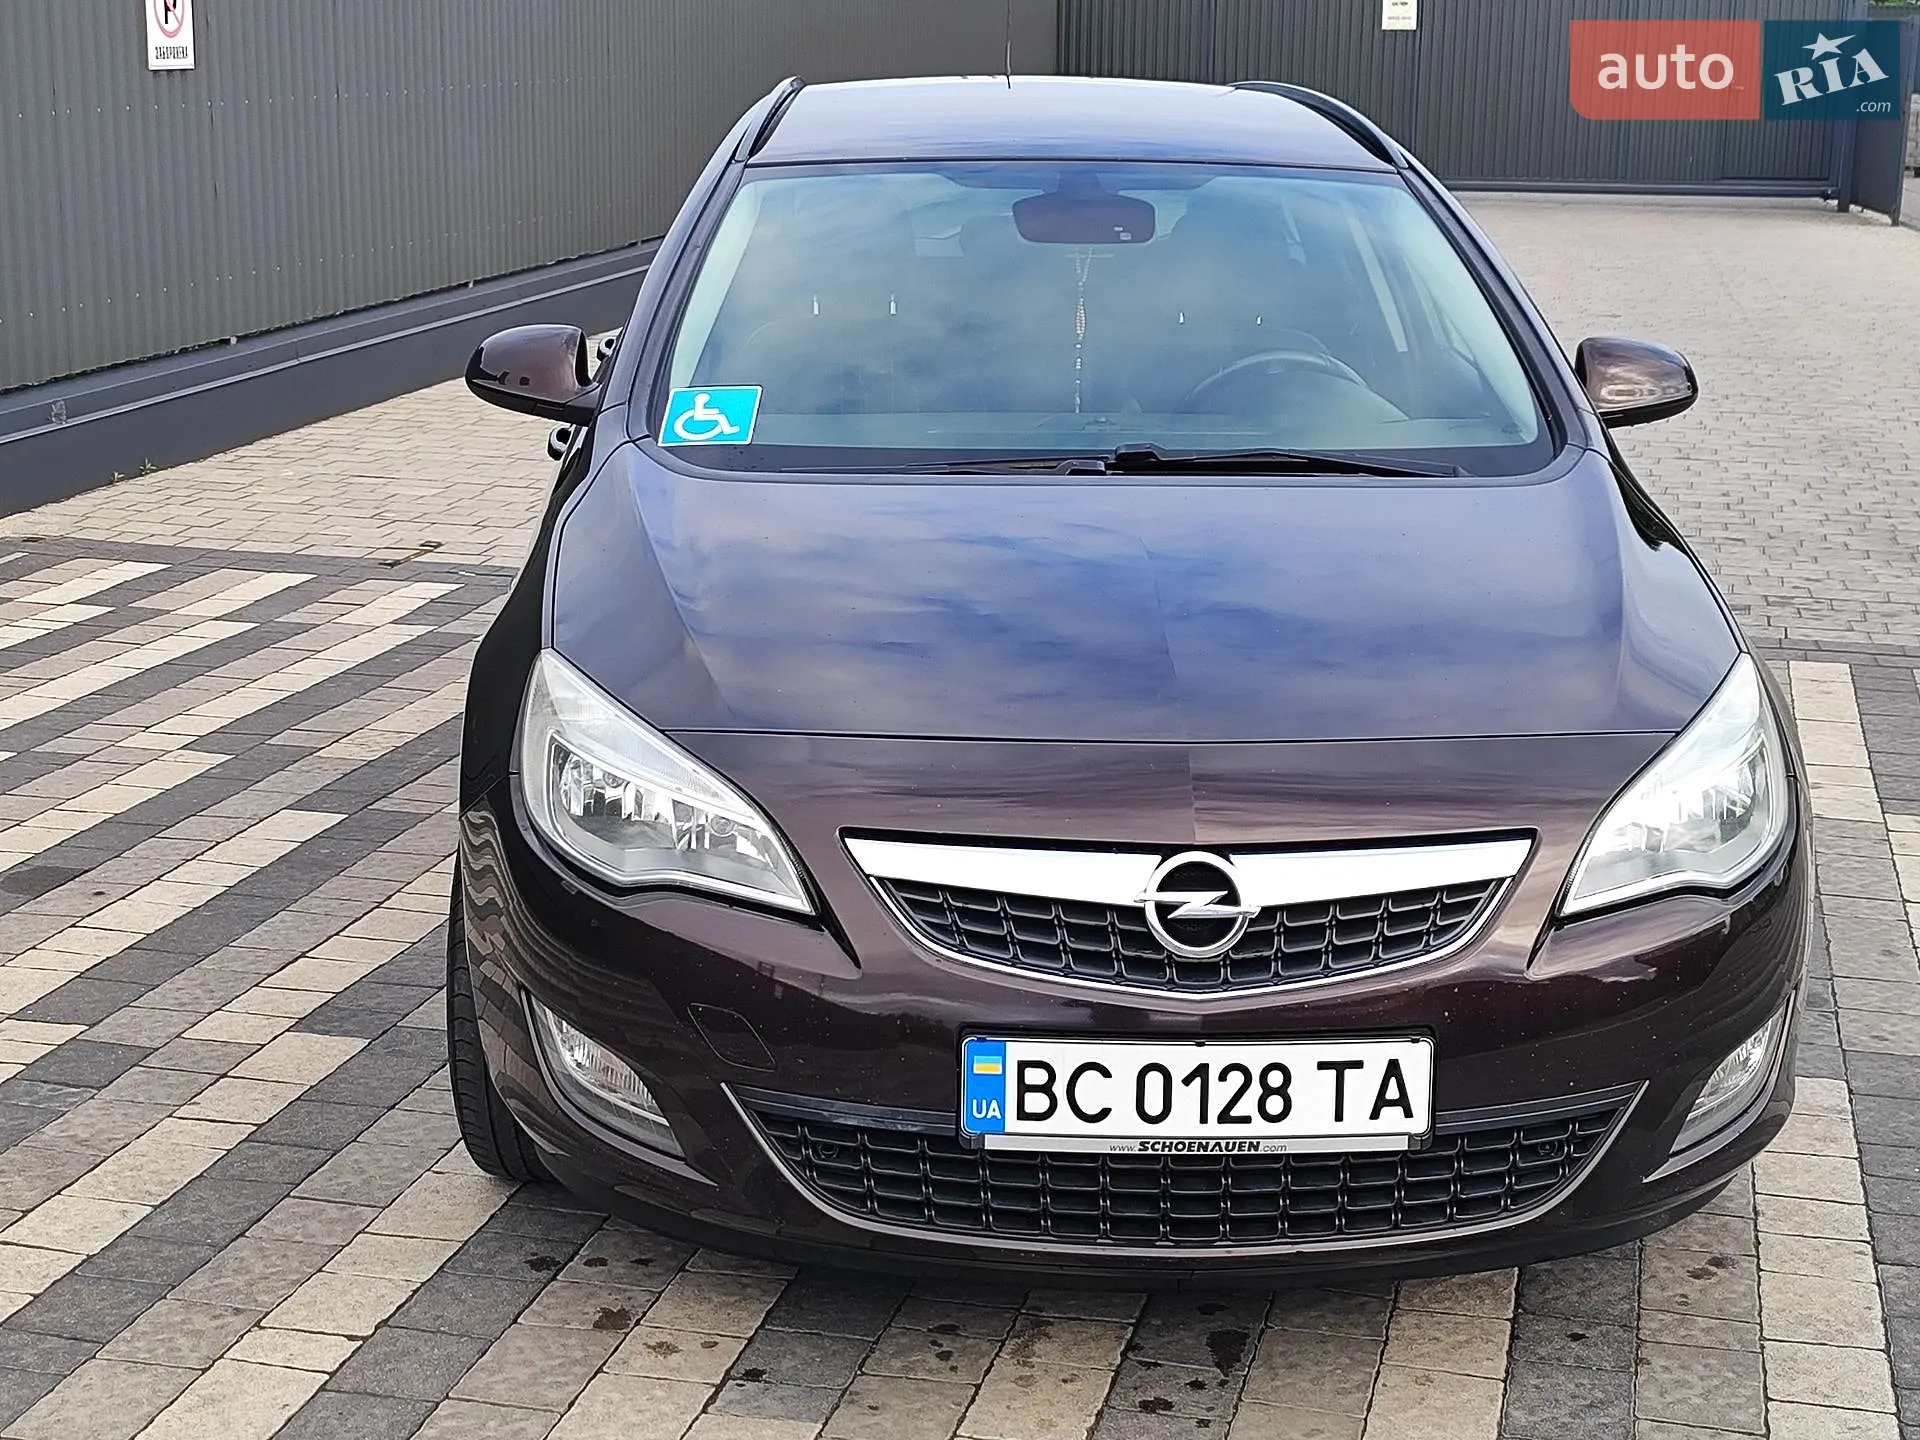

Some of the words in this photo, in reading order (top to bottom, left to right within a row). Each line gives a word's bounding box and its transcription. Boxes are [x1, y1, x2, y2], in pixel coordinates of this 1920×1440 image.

[1016, 1060, 1112, 1124] BC
[1135, 1062, 1293, 1125] 0128
[1317, 1058, 1414, 1122] TA
[972, 1099, 1001, 1119] UA
[1109, 1141, 1287, 1153] www.SCHOENAUEN.com
